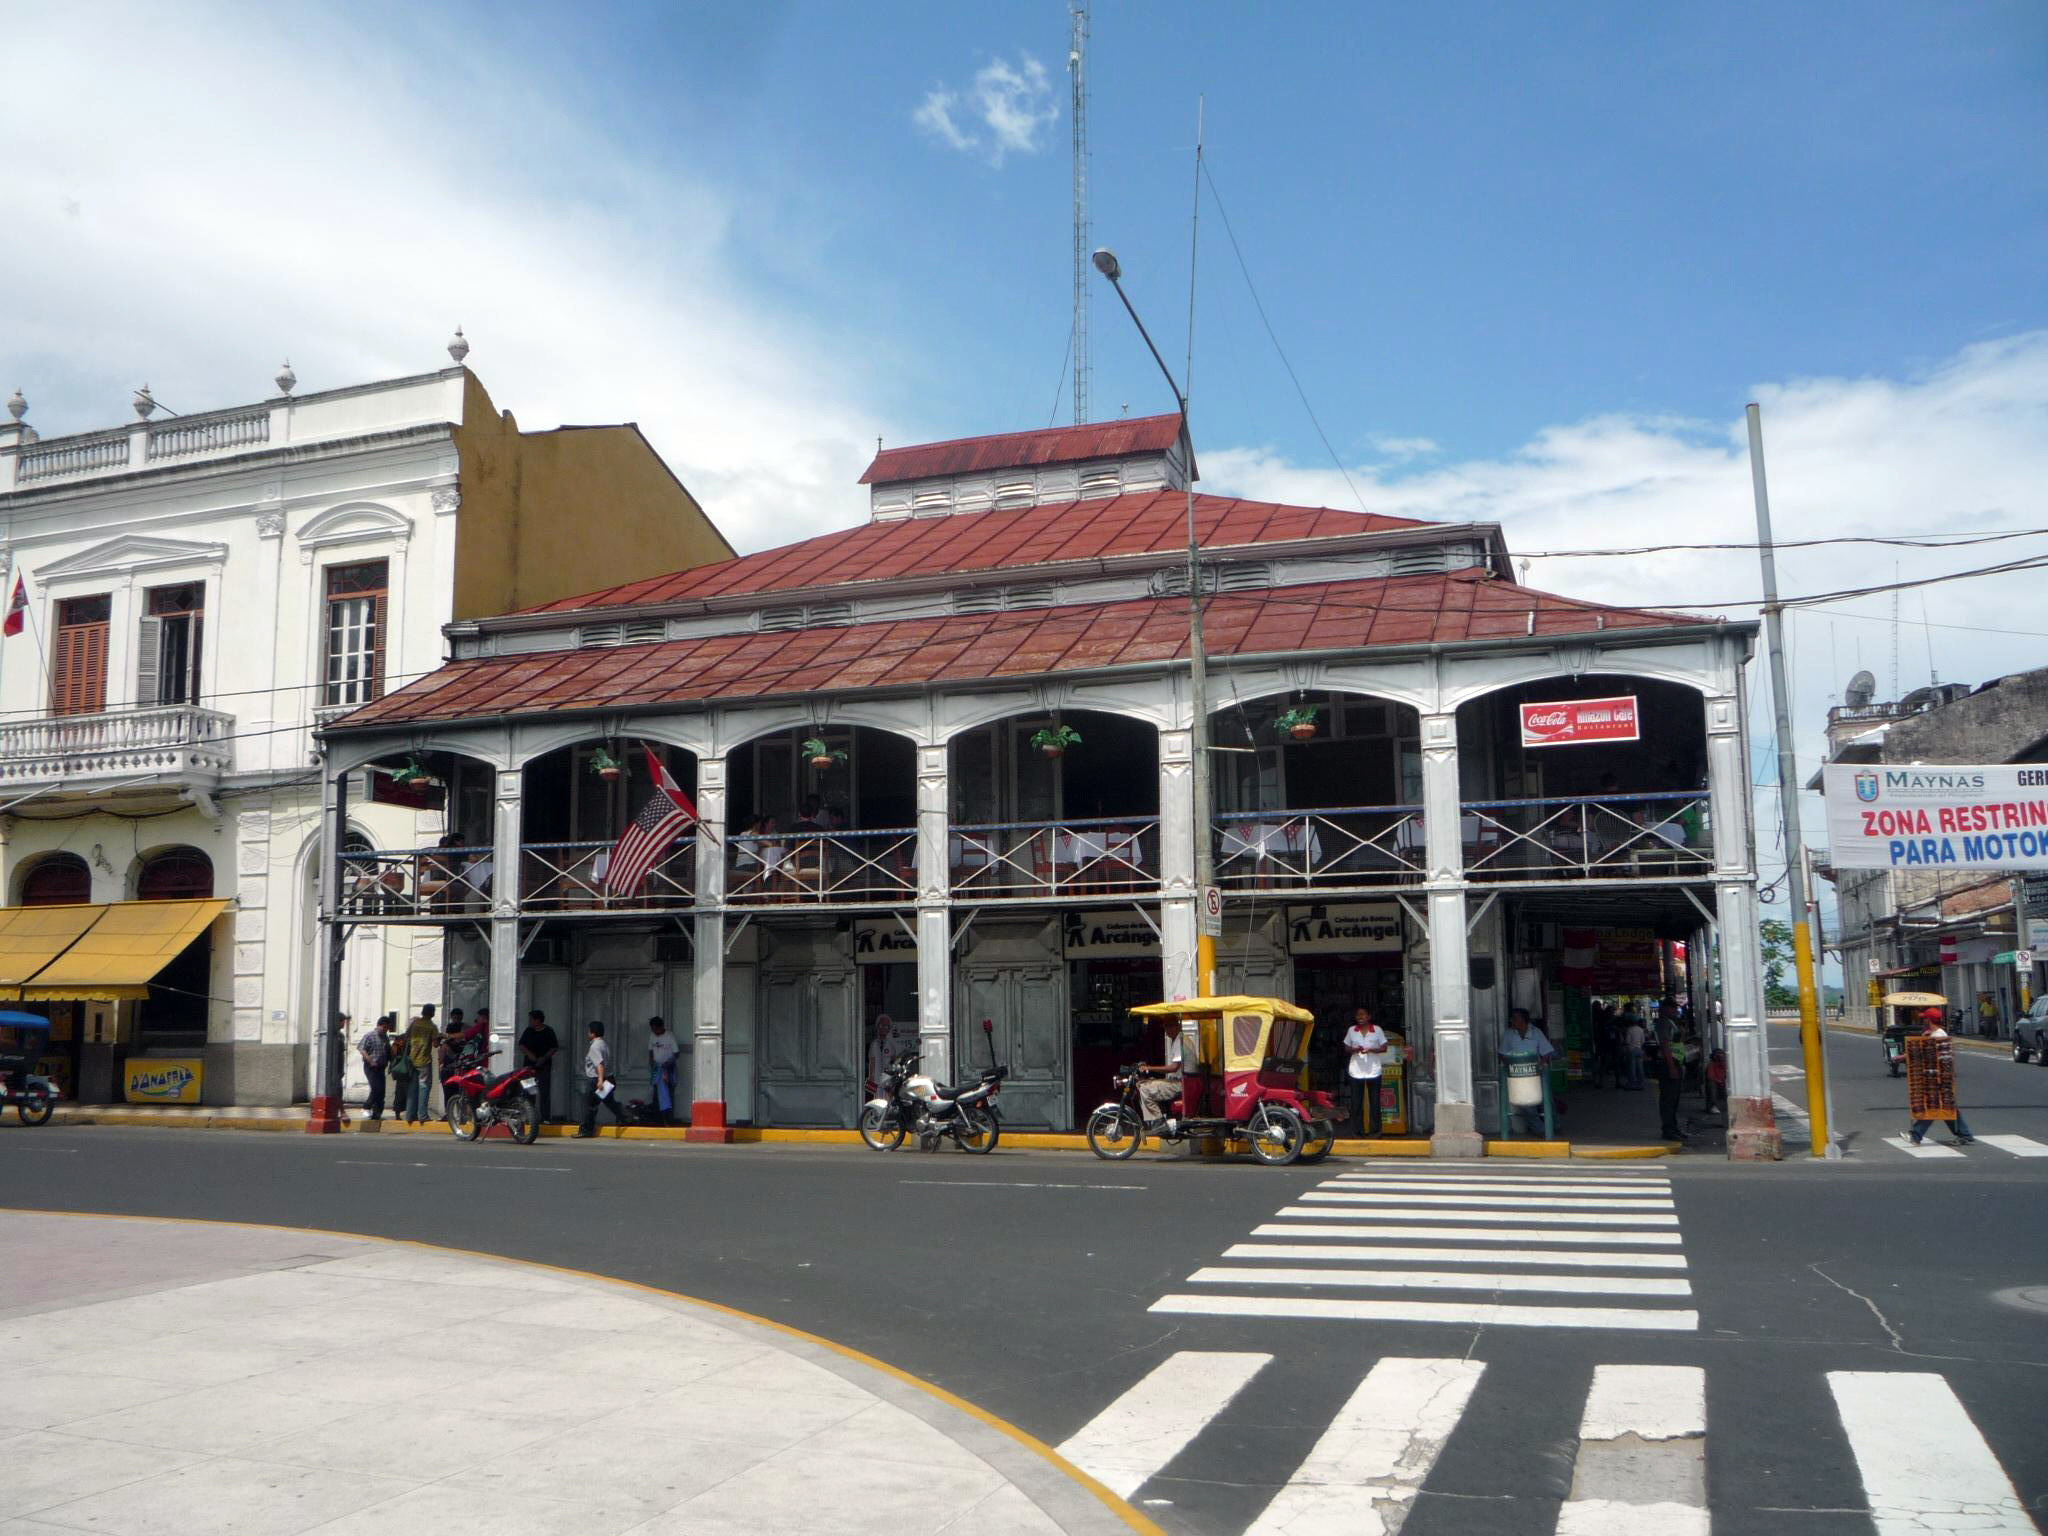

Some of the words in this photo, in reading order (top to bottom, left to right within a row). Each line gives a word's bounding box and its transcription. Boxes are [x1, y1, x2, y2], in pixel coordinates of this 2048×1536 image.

[1861, 809, 1932, 837] ZONA
[1938, 799, 2048, 833] RESTRIN
[1890, 837, 1956, 865] PARA
[1318, 921, 1400, 940] Arcángel
